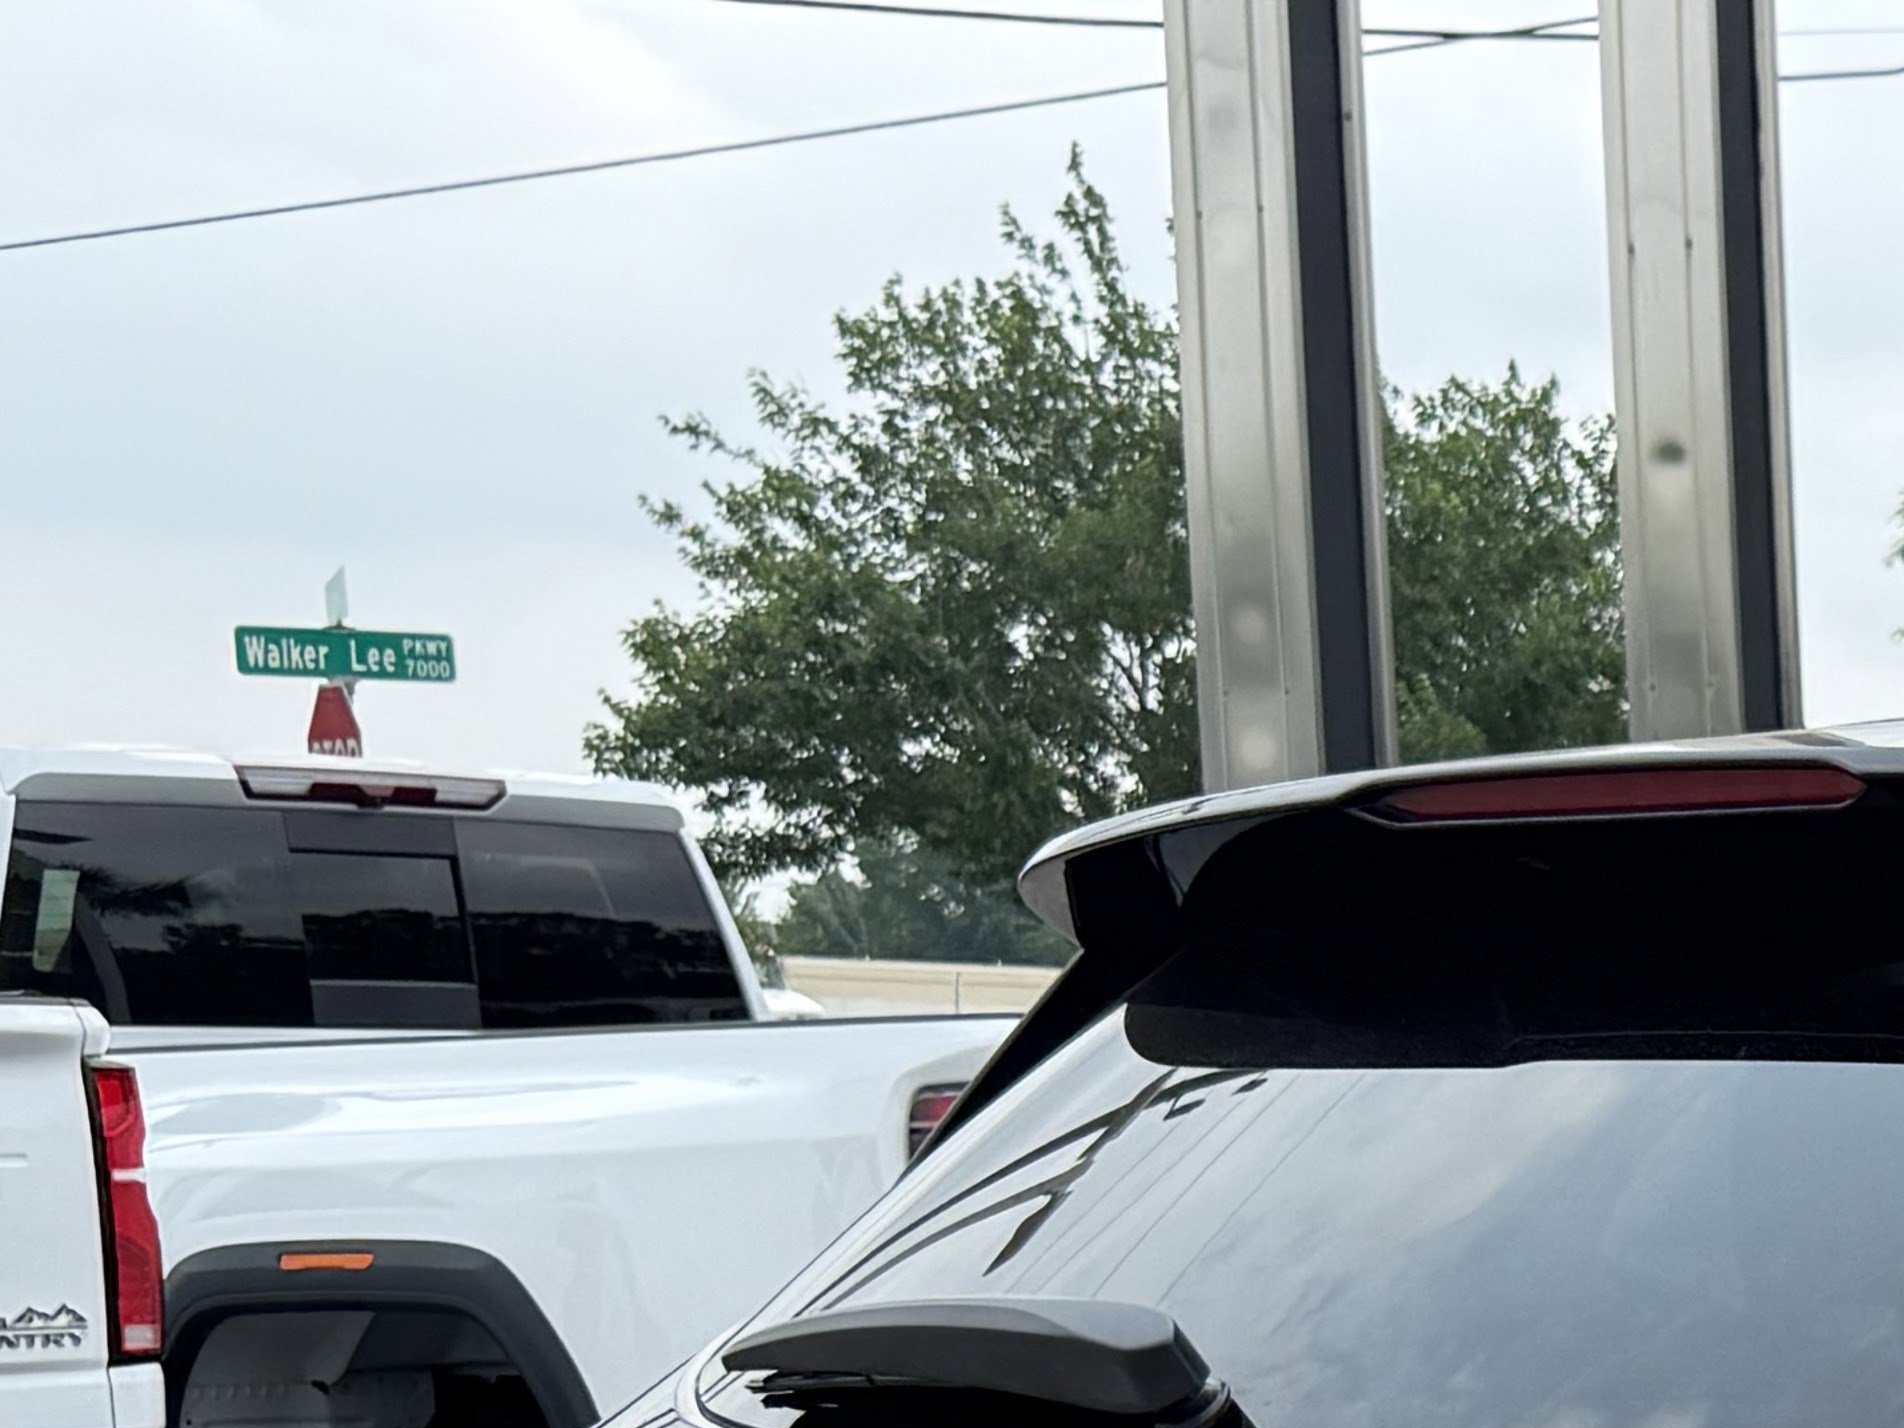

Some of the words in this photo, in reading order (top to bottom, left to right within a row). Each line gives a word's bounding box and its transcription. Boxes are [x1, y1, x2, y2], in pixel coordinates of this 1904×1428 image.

[244, 635, 329, 670] Walker
[350, 639, 396, 673] Lee
[403, 638, 448, 656] PKWY
[405, 660, 450, 678] 7000
